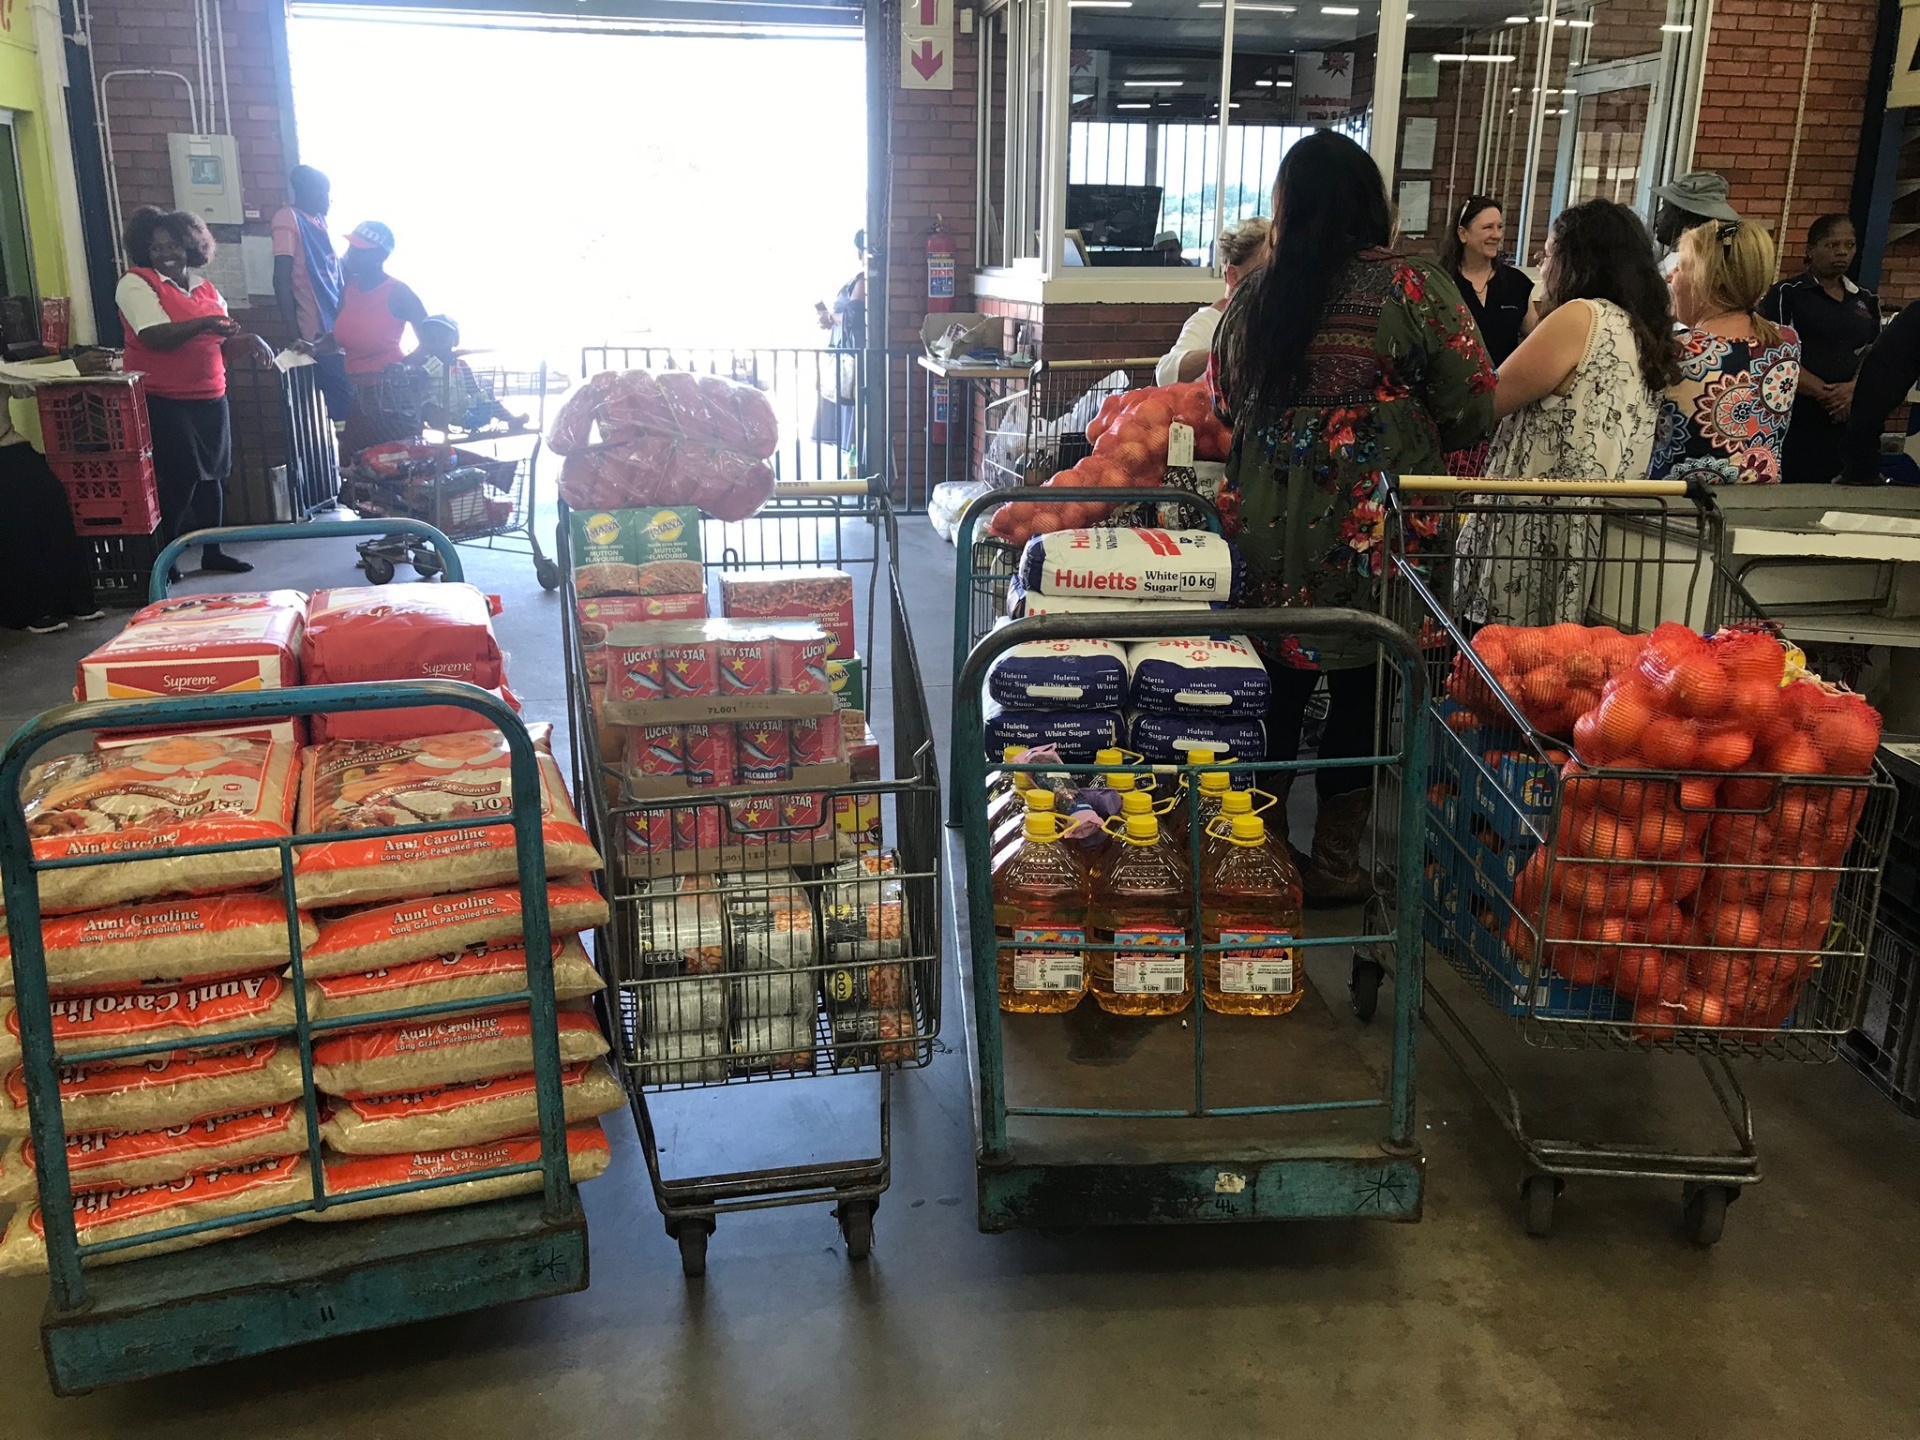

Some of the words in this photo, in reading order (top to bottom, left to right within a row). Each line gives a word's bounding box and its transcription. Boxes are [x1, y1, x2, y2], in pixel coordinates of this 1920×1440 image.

[1055, 569, 1137, 591] Huletts
[1145, 571, 1178, 581] White
[1181, 575, 1196, 587] 10
[1200, 574, 1215, 589] kg
[1144, 582, 1178, 593] Sugar
[623, 650, 651, 666] LUCKY
[683, 649, 706, 661] STAR
[740, 647, 761, 659] STAR
[422, 662, 473, 677] Supreme
[1000, 672, 1027, 680] Huletts
[164, 675, 217, 692] Supreme
[1151, 685, 1173, 694] Sugar
[762, 720, 783, 731] STAR
[1187, 728, 1214, 736] Huletts
[645, 726, 673, 740] LUCKY
[1017, 731, 1038, 739] Sugar
[1068, 730, 1091, 738] Sugar
[1148, 732, 1170, 740] Sugar
[473, 797, 502, 812] 10
[754, 799, 773, 810] STAR
[791, 796, 812, 808] STAR
[384, 840, 419, 851] Aunt
[424, 829, 487, 846] Caroline
[67, 842, 107, 855] Aunt
[393, 909, 428, 924] Aunt
[432, 896, 495, 915] Caroline
[84, 918, 124, 931] Aunt
[130, 910, 199, 927] Caroline
[390, 925, 412, 934] Long
[414, 920, 438, 930] Grain
[440, 910, 480, 924] Parboiled
[483, 907, 502, 915] Rice
[107, 930, 134, 939] Grain
[137, 924, 181, 936] Parboiled
[184, 922, 205, 930] Rice
[187, 977, 267, 1011] Aunt
[51, 990, 179, 1023] Carolin
[400, 1026, 432, 1042] Aunt
[437, 1017, 497, 1035] Caroline
[418, 1039, 440, 1048] Grain
[444, 1033, 482, 1044] Parboiled
[413, 1154, 445, 1167] Aunt
[451, 1148, 508, 1161] Caroline
[408, 1168, 429, 1176] Long
